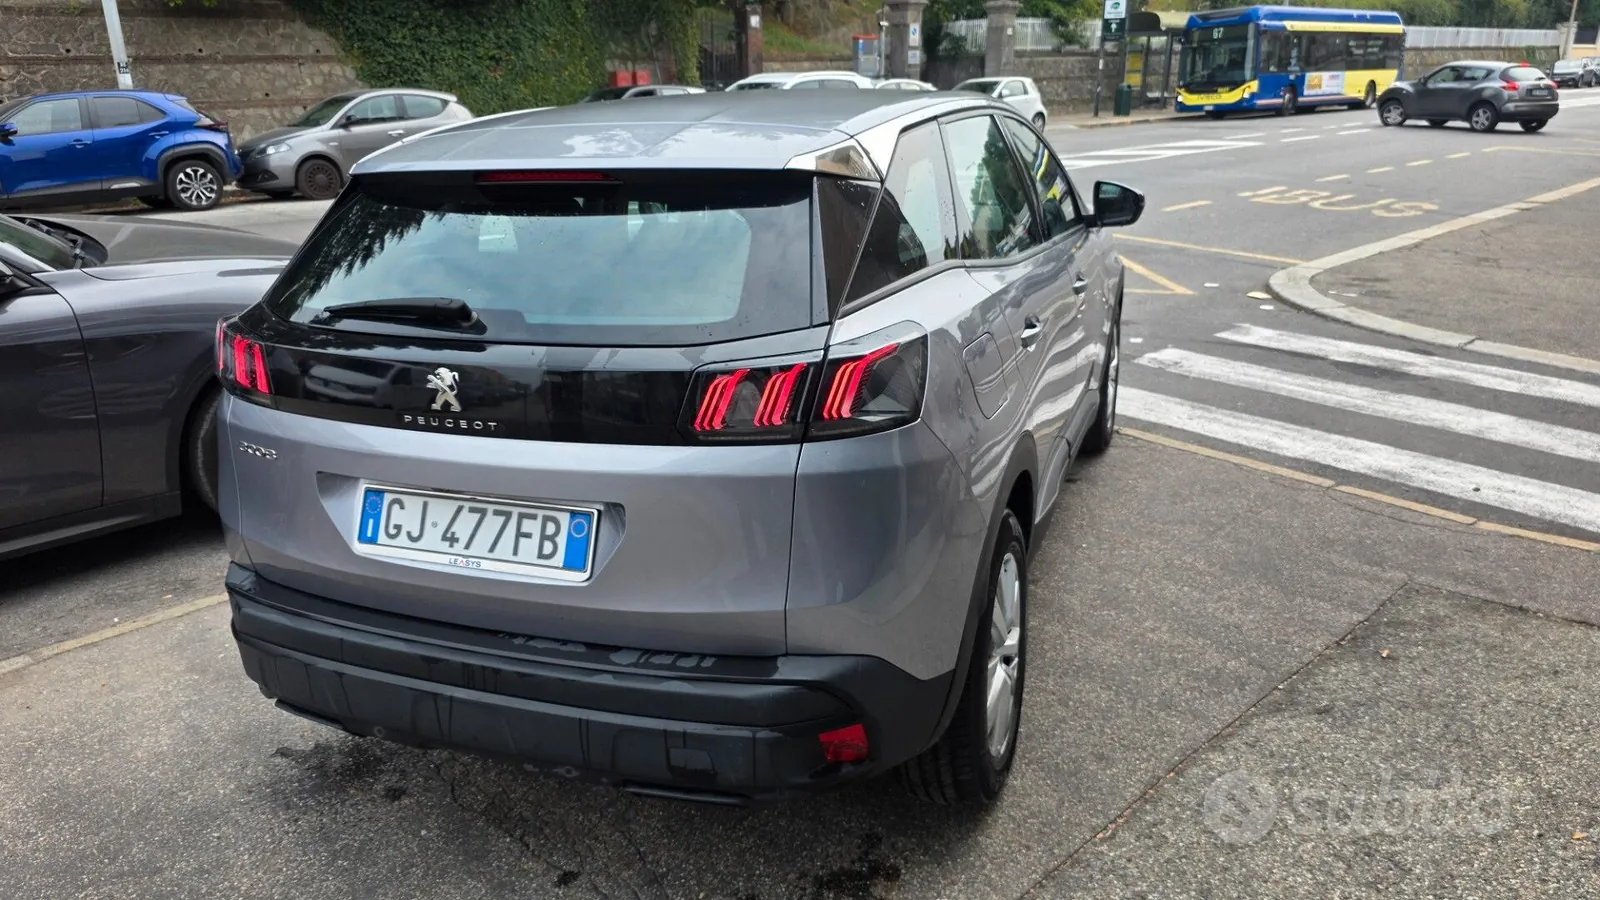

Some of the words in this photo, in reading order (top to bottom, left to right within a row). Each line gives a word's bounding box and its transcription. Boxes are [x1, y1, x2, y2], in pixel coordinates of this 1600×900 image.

[1212, 27, 1224, 39] 67
[1236, 186, 1439, 217] BUS
[404, 415, 498, 430] PEUGEOT
[239, 440, 278, 460] 3008
[384, 497, 429, 543] GJ
[440, 504, 562, 561] 477FB
[448, 557, 482, 568] LEASYS
